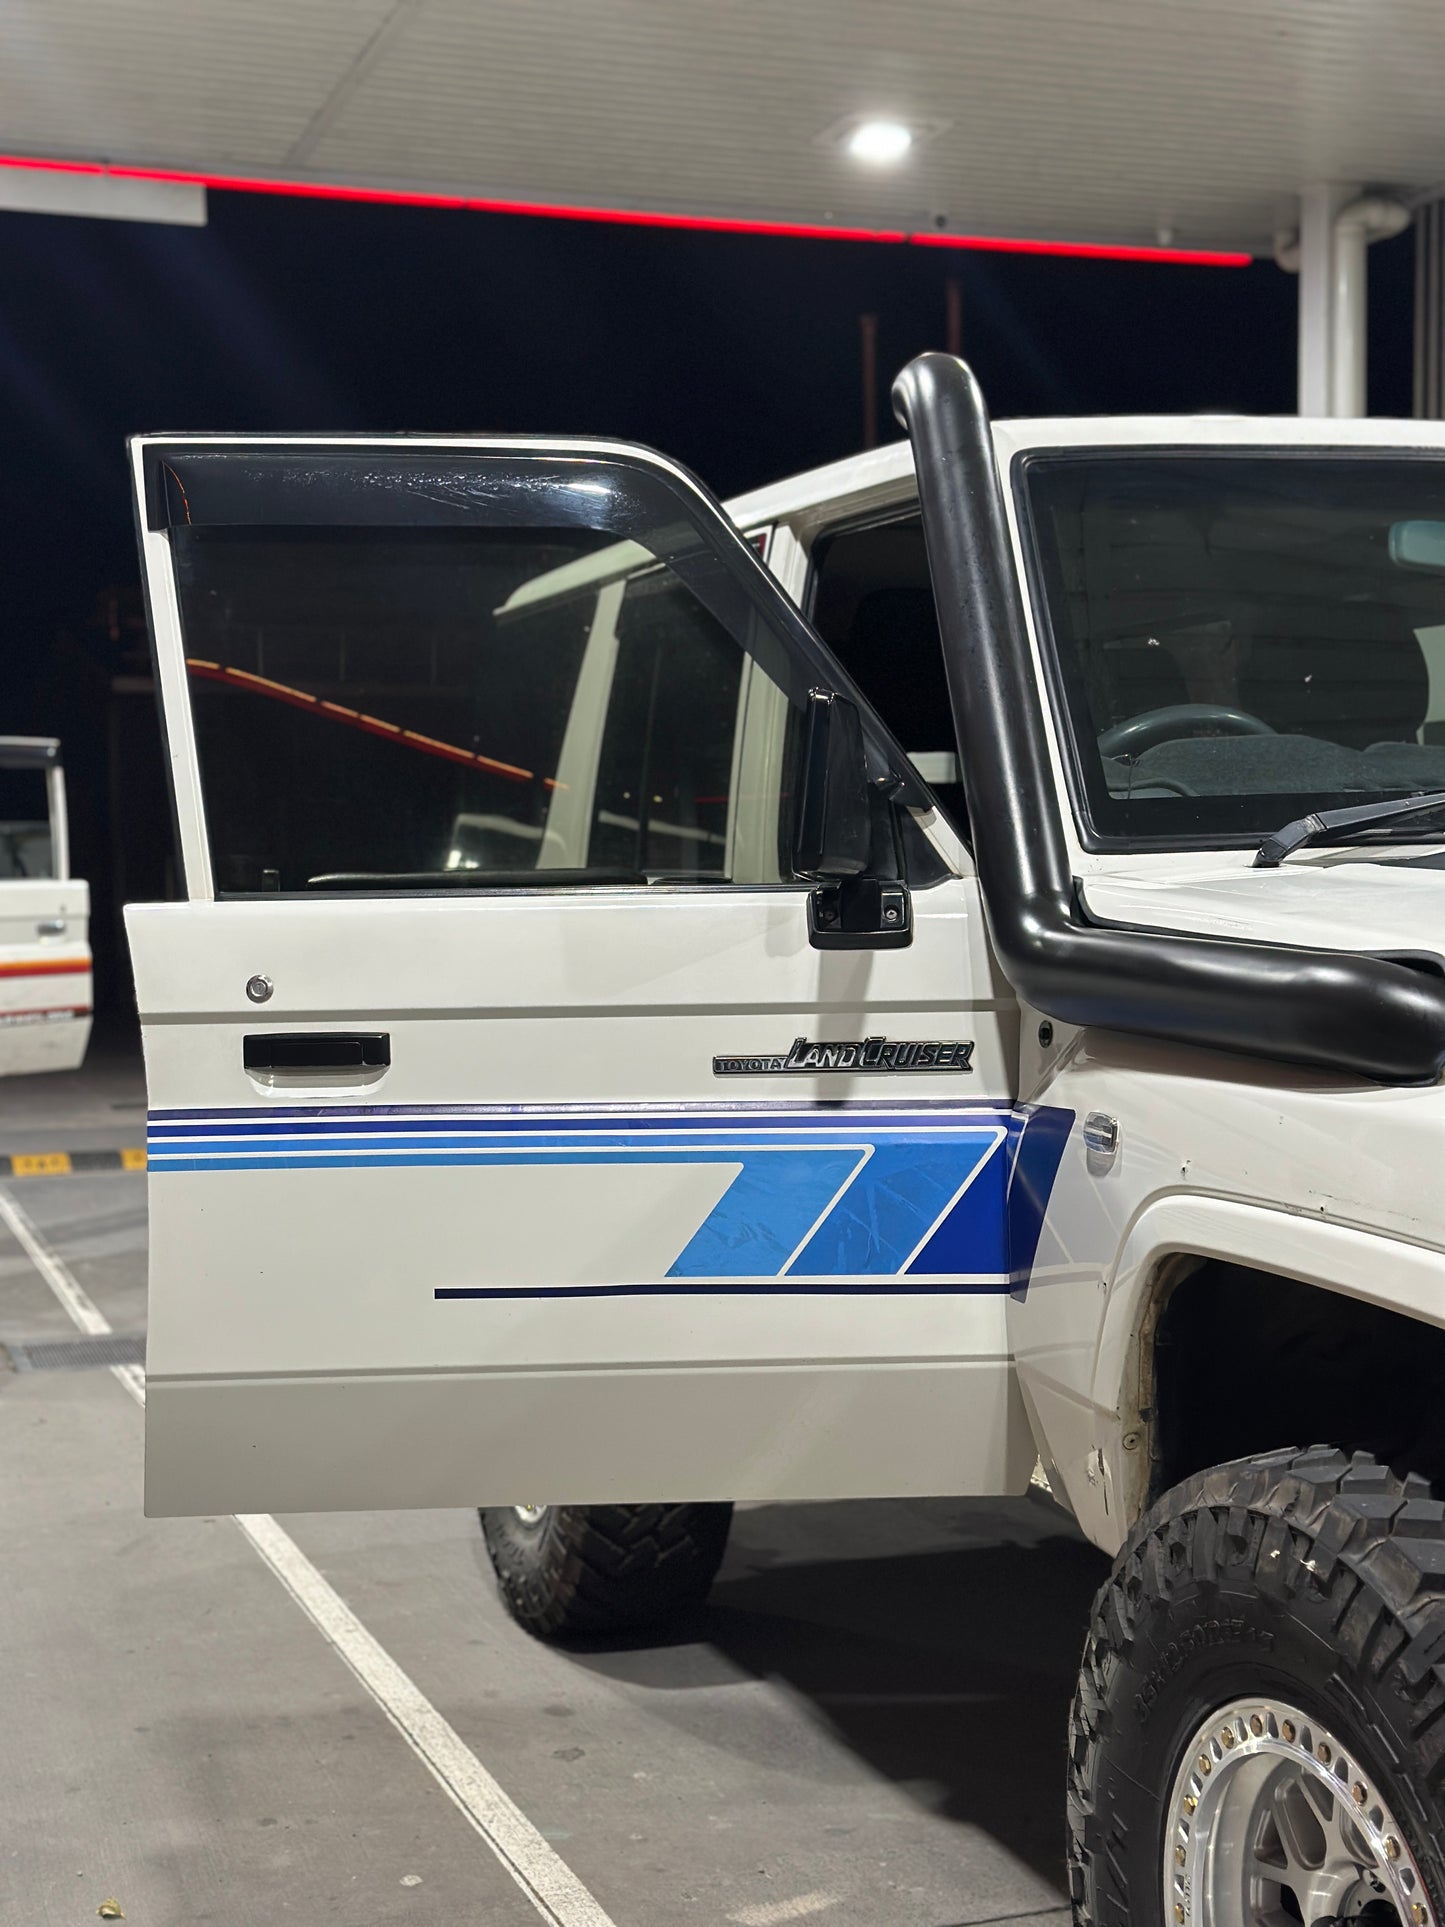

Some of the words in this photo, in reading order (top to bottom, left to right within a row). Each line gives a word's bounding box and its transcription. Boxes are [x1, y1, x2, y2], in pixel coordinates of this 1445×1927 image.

[718, 1059, 786, 1071] TOYOTA
[786, 1037, 859, 1069] LAND
[859, 1036, 974, 1070] CRUISER
